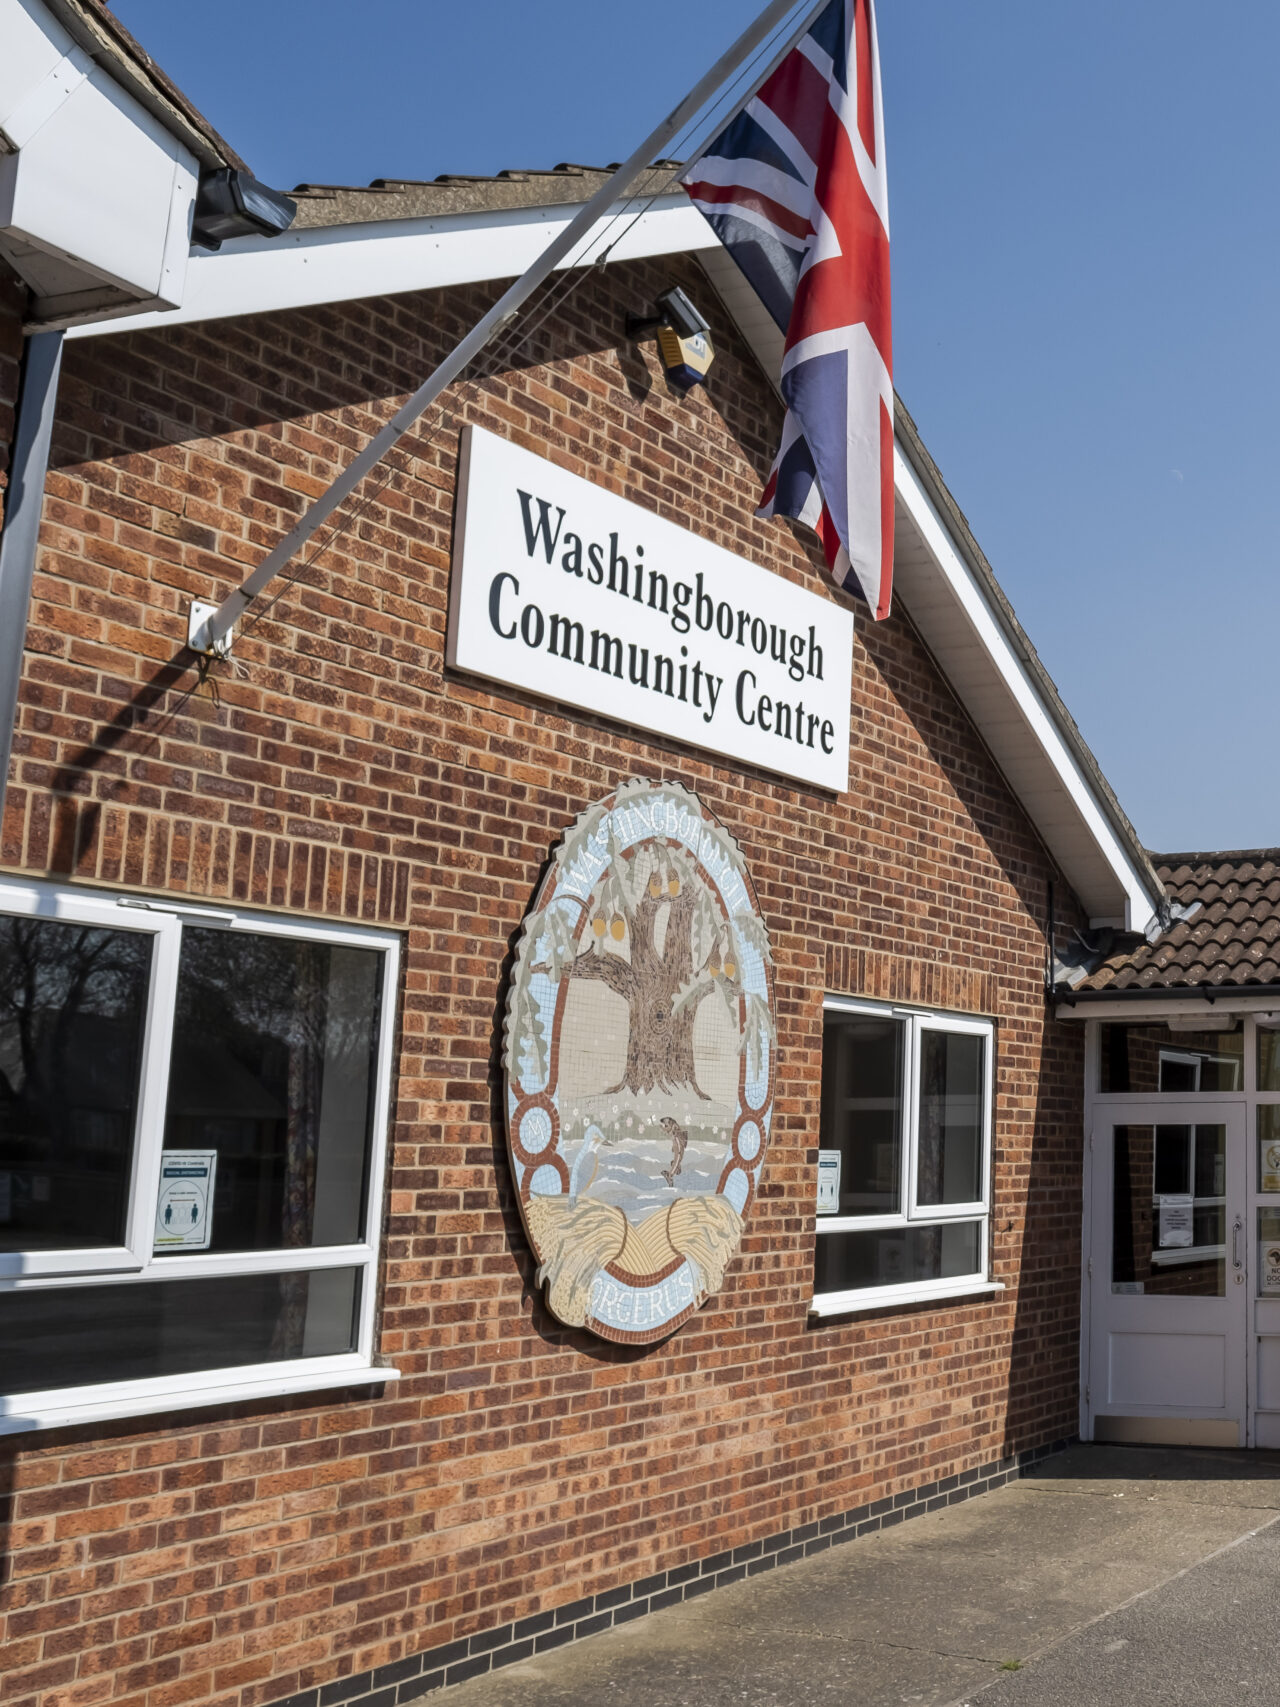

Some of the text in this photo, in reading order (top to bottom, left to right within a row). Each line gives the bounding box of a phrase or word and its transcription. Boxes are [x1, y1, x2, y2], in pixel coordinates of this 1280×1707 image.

[488, 572, 835, 755] Community Centre
[516, 488, 824, 682] Washingborough
[588, 1268, 693, 1325] ORGERUS
